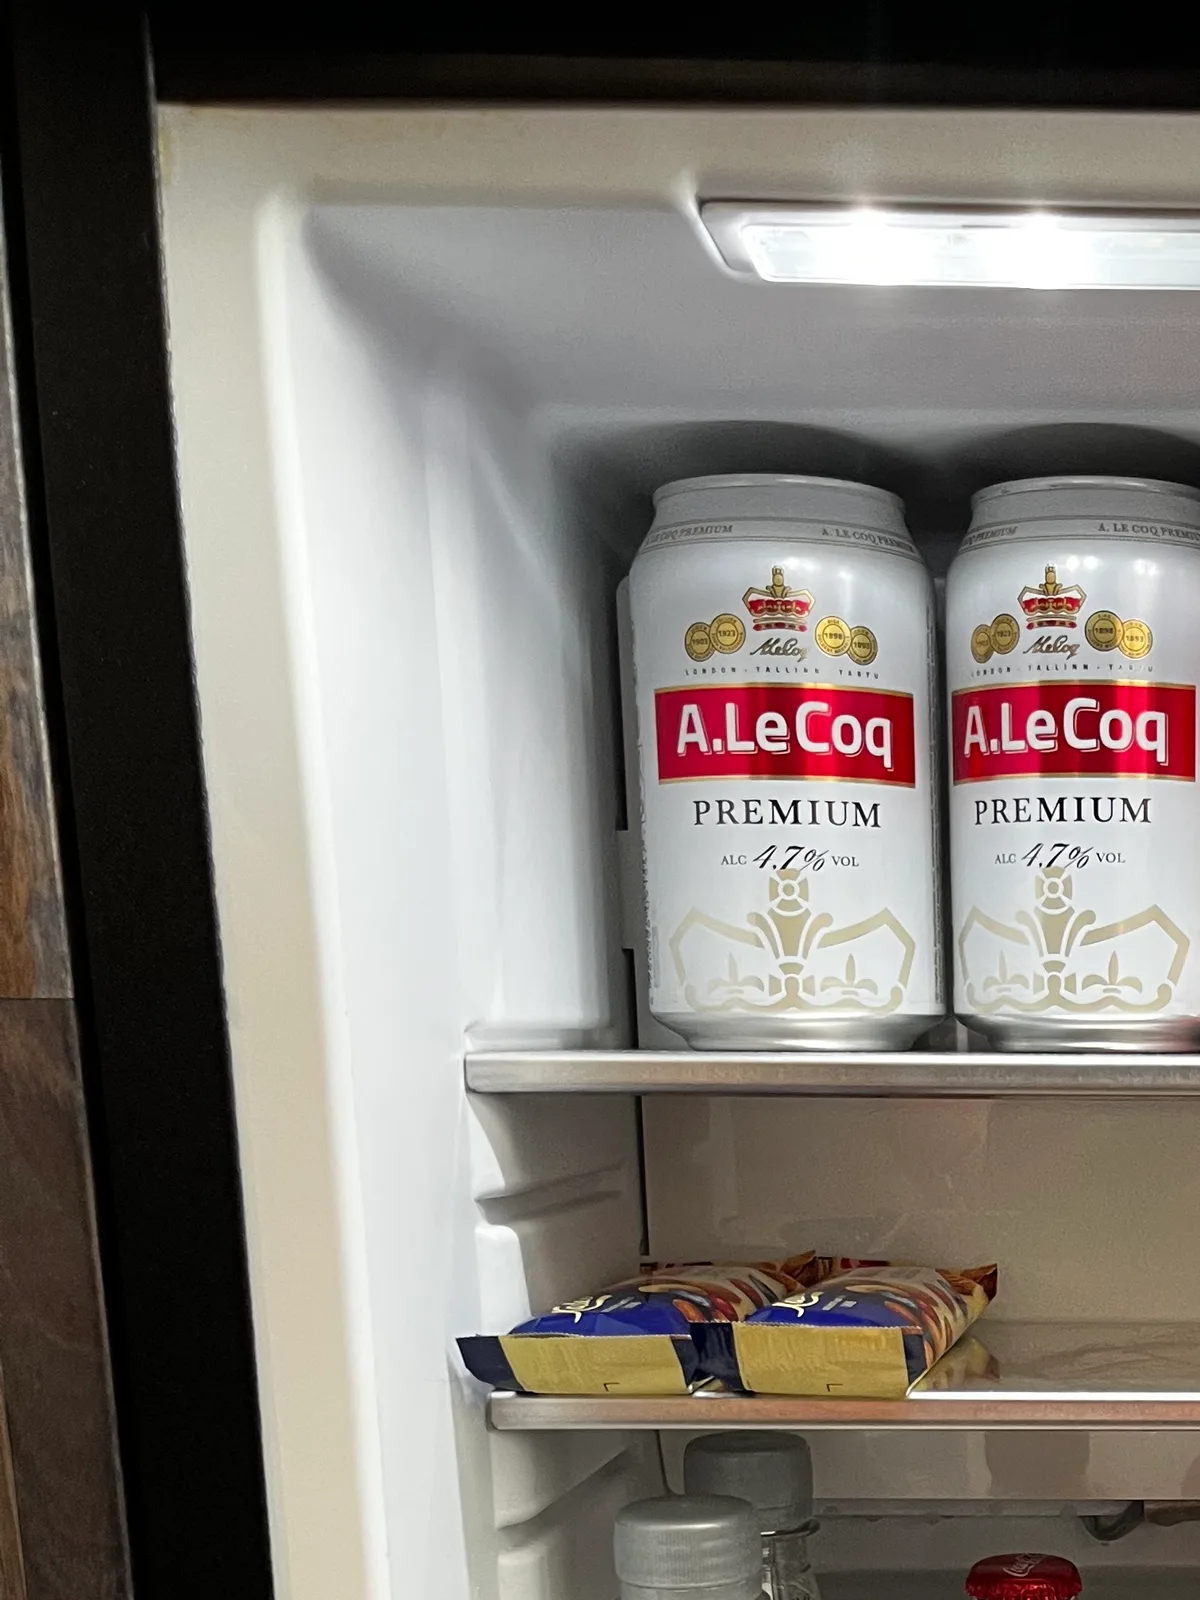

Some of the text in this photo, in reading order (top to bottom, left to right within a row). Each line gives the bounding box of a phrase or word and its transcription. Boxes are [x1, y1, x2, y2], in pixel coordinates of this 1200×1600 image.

[1113, 523, 1129, 533] LE
[1131, 524, 1160, 538] COQ
[692, 798, 882, 829] PREMIUM
[974, 796, 1153, 826] PREMIUM
[720, 844, 860, 872] ALC 4.7% VOL
[994, 843, 1126, 869] ALC 4.7% VOL
